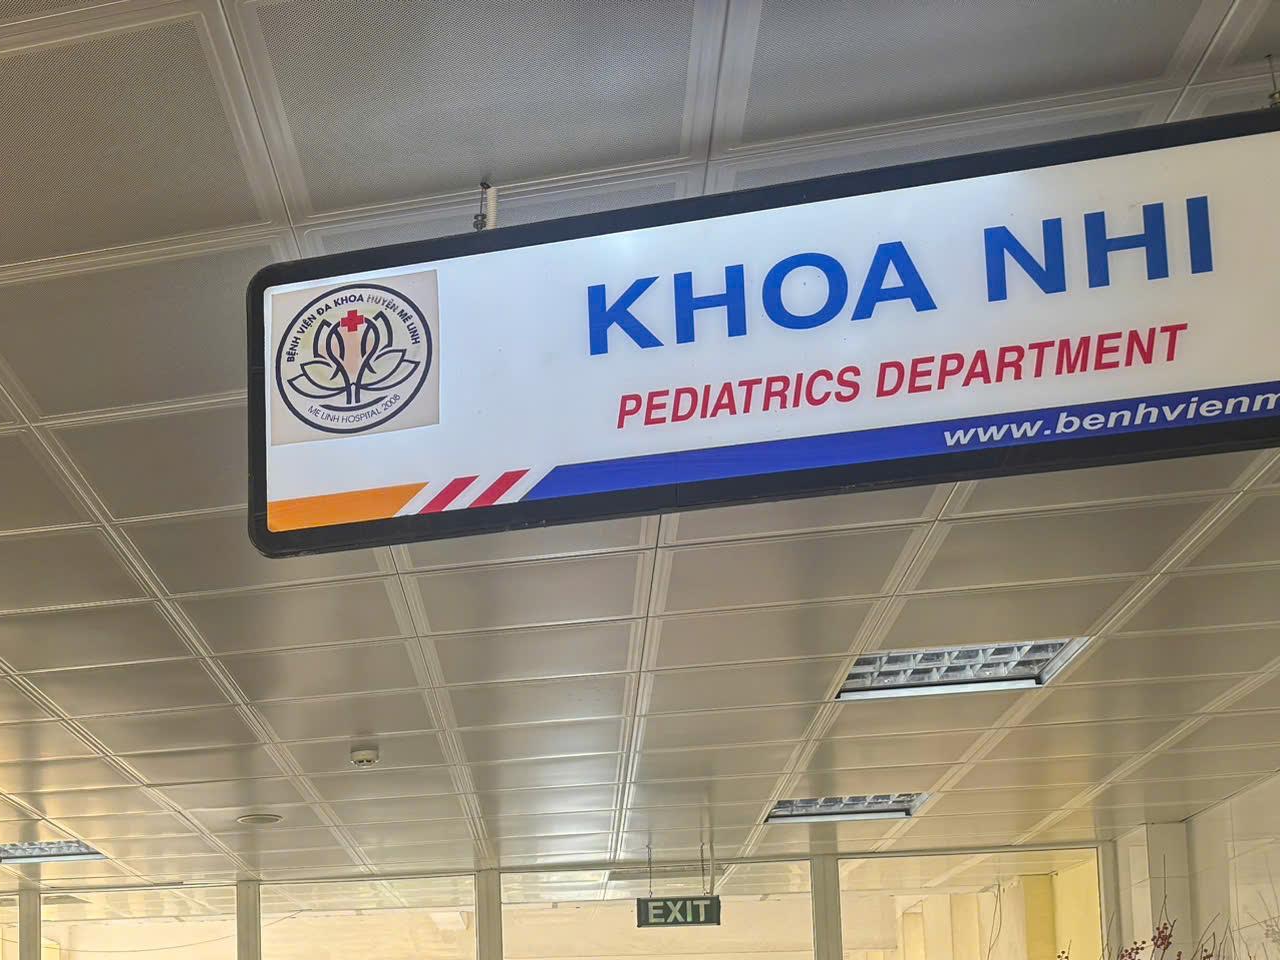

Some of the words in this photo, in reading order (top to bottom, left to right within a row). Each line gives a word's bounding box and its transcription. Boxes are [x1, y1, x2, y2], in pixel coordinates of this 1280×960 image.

[587, 240, 937, 356] KHOA
[983, 195, 1213, 303] NHI
[286, 336, 301, 363] BỆNH
[298, 313, 317, 336] VIỆN
[316, 303, 331, 317] ĐA
[333, 294, 364, 308] KHOA
[396, 308, 412, 323] MÊ
[407, 321, 421, 345] LINH
[320, 411, 340, 423] LINH
[341, 408, 382, 424] HOSPITAL
[381, 393, 401, 411] 2008
[615, 365, 861, 430] PEDIATRICS
[875, 322, 1189, 398] DEPARTMENT
[648, 900, 711, 923] EXIT
